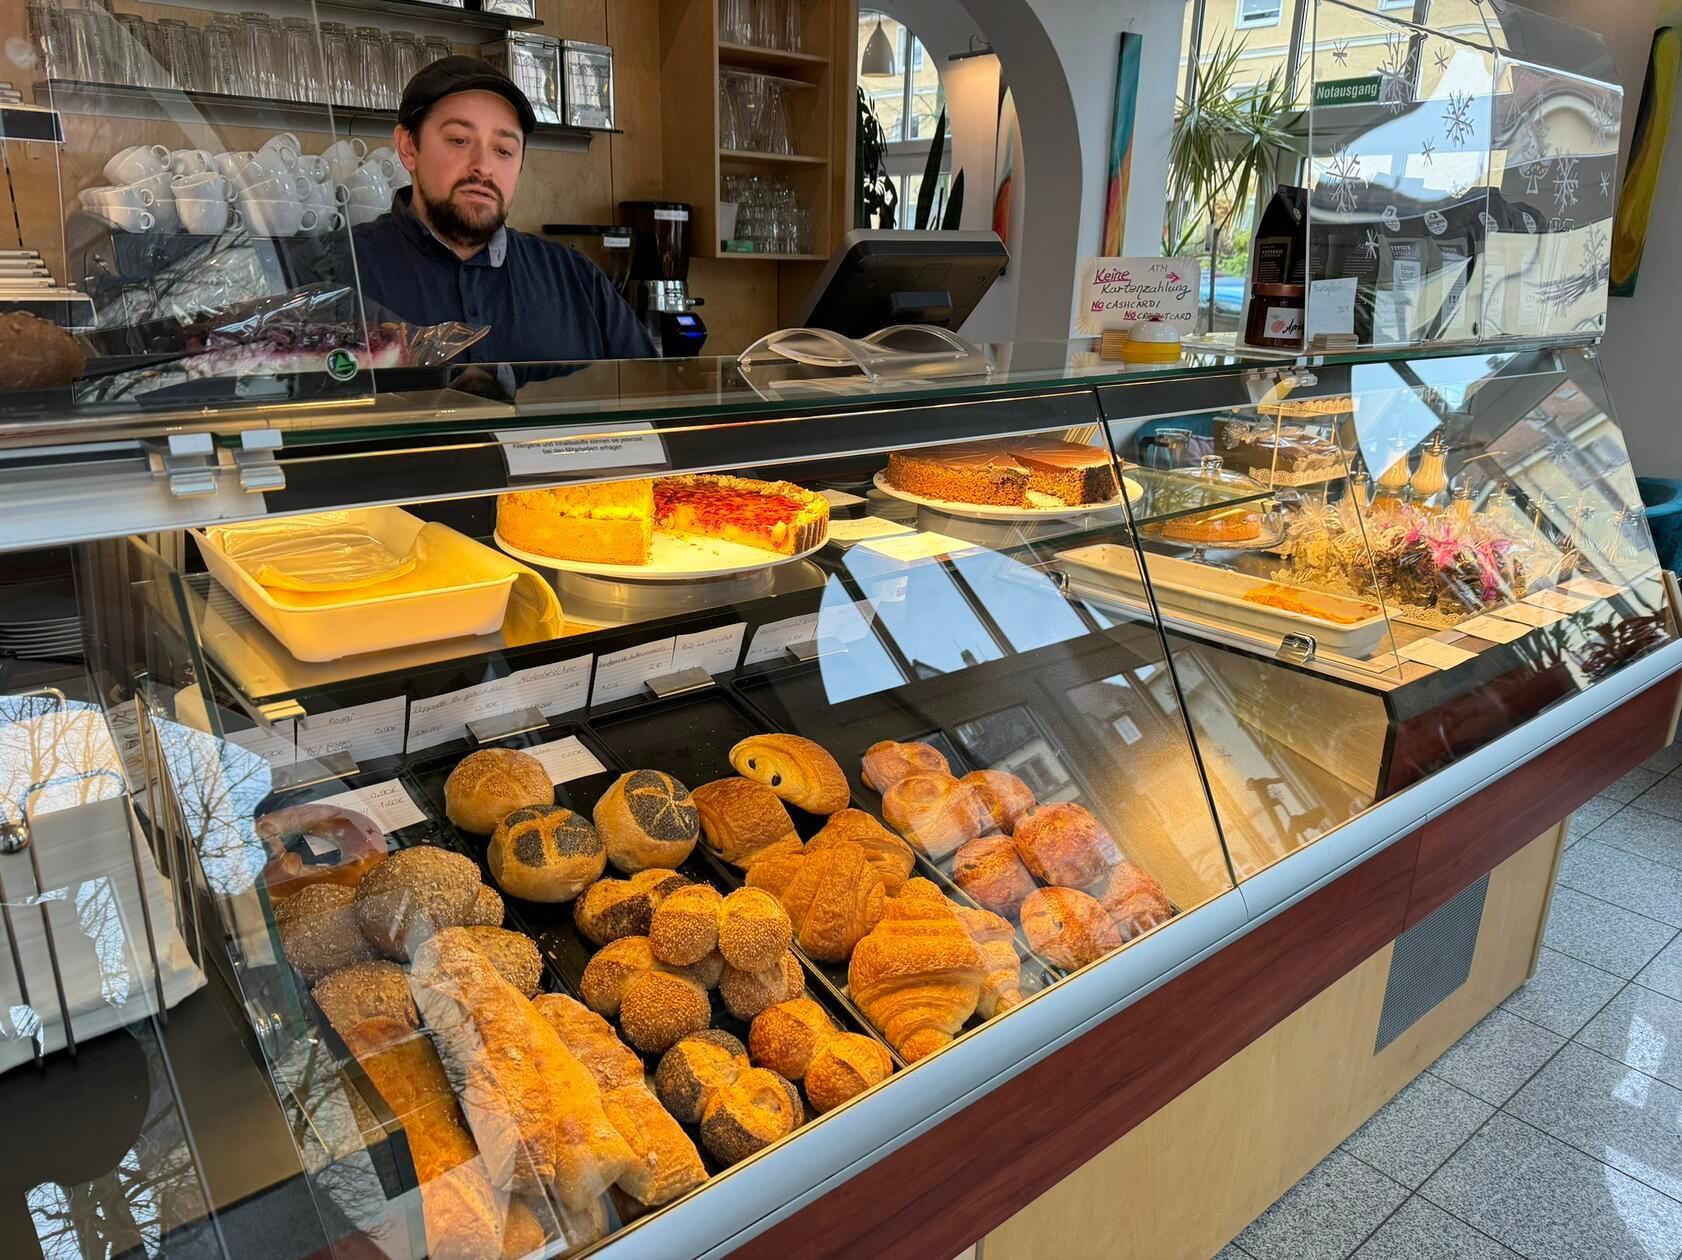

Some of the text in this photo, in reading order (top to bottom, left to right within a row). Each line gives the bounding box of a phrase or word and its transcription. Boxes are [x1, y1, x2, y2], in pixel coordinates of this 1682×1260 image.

[1316, 83, 1378, 100] Notausgang
[1148, 264, 1168, 272] ATM
[1095, 268, 1131, 282] Keine
[1101, 280, 1192, 300] Kartenzahlung
[1091, 300, 1105, 310] NO
[1124, 311, 1137, 320] NO
[599, 444, 623, 452] erfragen
